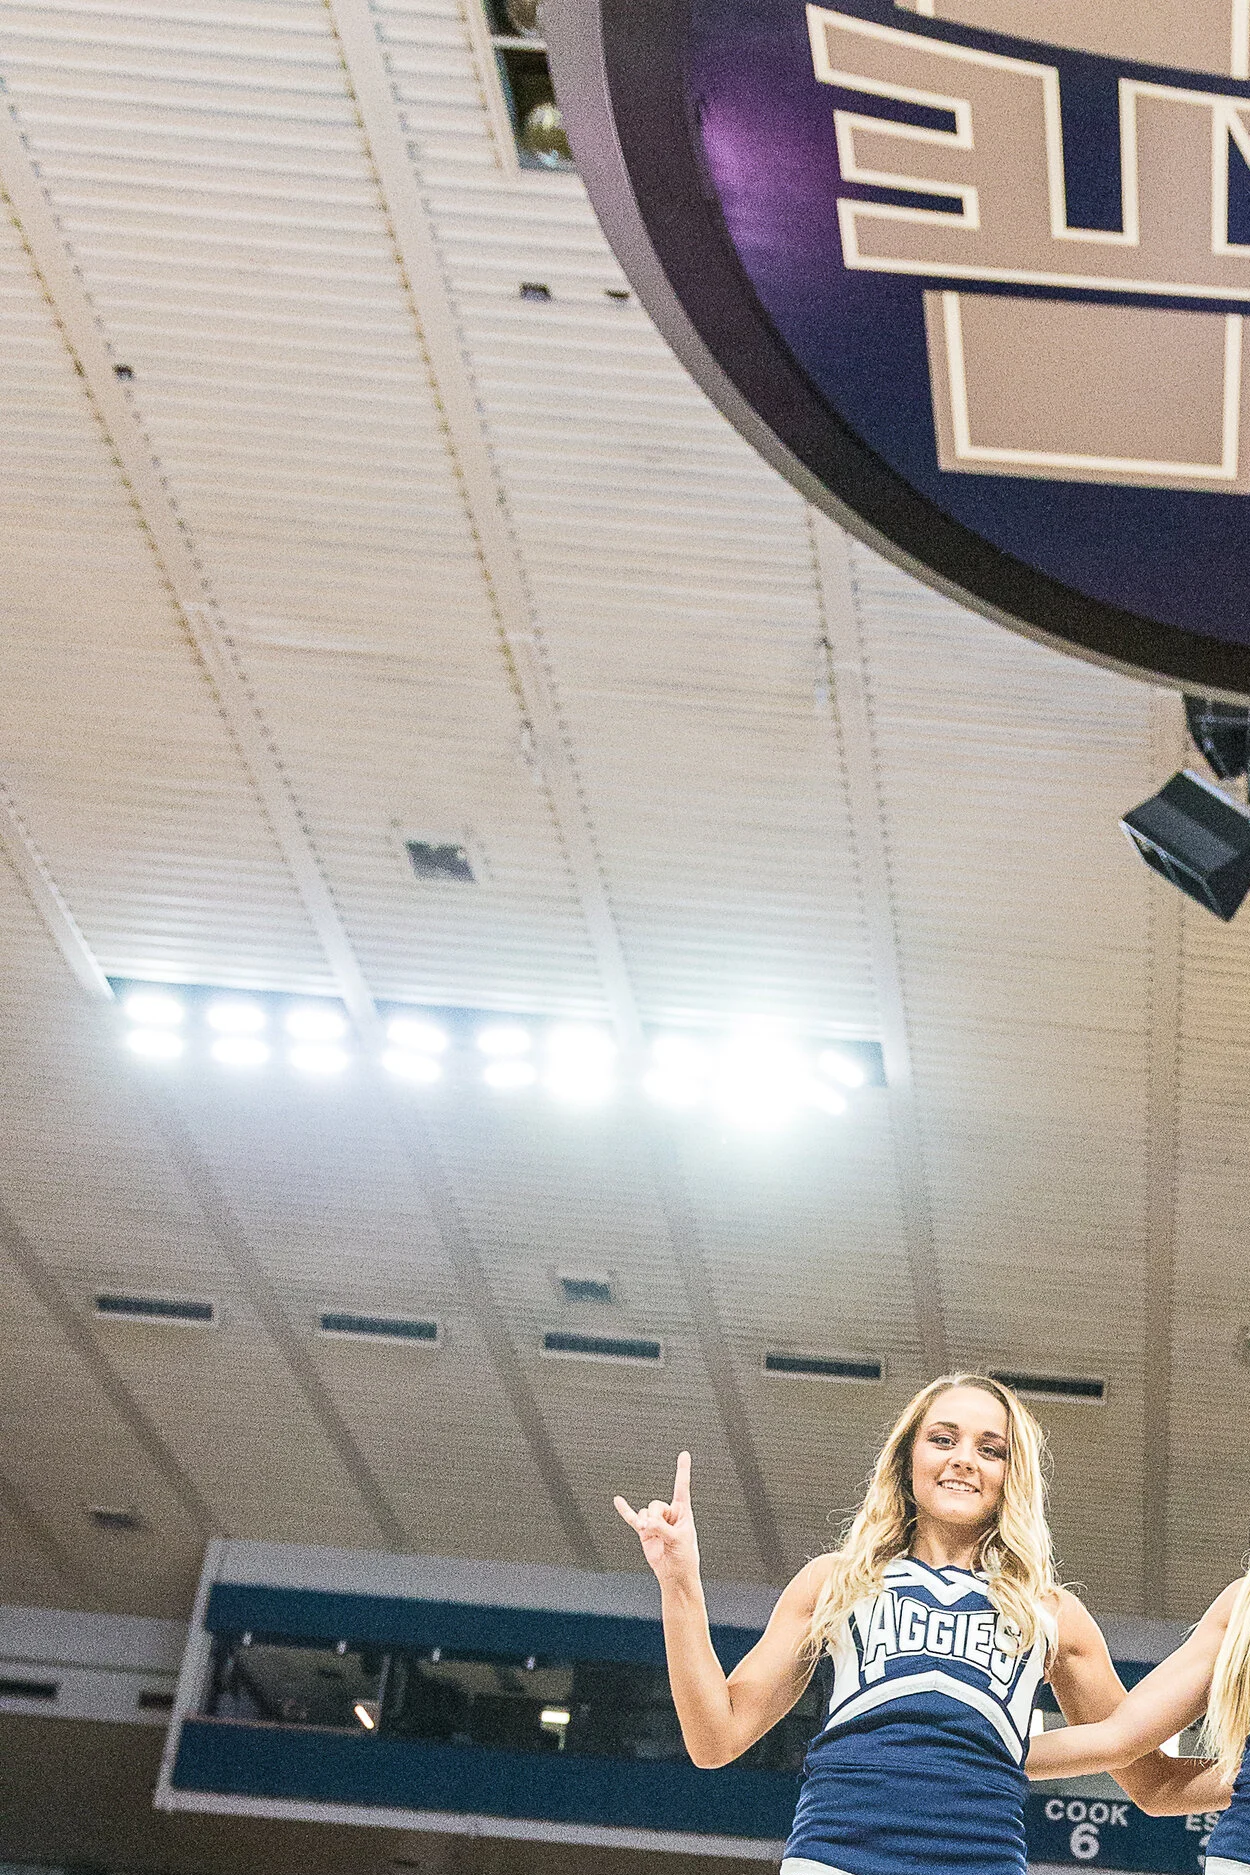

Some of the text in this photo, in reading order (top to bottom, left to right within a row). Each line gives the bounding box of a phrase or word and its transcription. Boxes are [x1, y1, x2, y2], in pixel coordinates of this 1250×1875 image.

[861, 1588, 1023, 1685] AGGIES
[1044, 1798, 1129, 1828] COOK
[1069, 1822, 1100, 1860] 6
